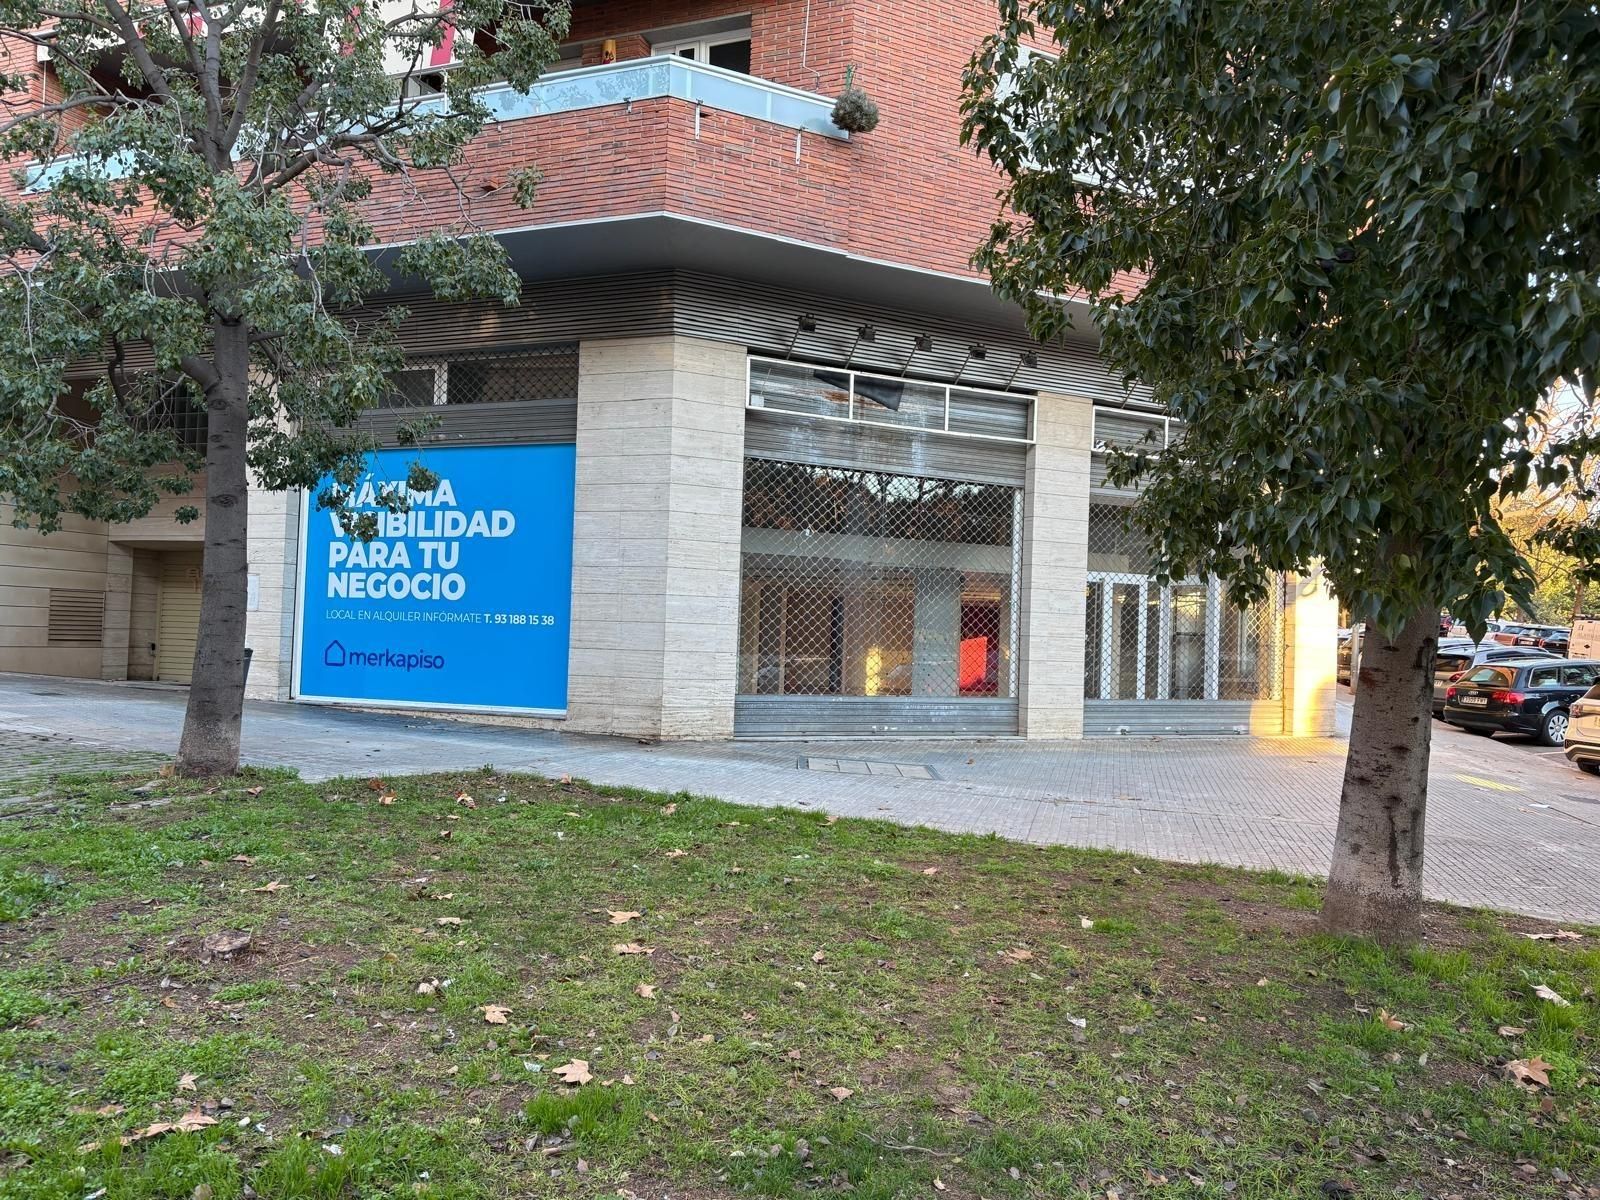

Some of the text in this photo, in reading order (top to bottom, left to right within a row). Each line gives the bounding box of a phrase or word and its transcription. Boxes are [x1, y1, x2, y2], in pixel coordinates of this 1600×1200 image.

[329, 510, 516, 538] VIBILIDAD
[328, 541, 460, 570] PARA TU
[327, 572, 466, 601] NEGOCIO
[326, 609, 555, 626] LOCAL EN ALQUILER INFÓRMATE T. 93 188 15 38
[349, 648, 445, 672] merkapiso
